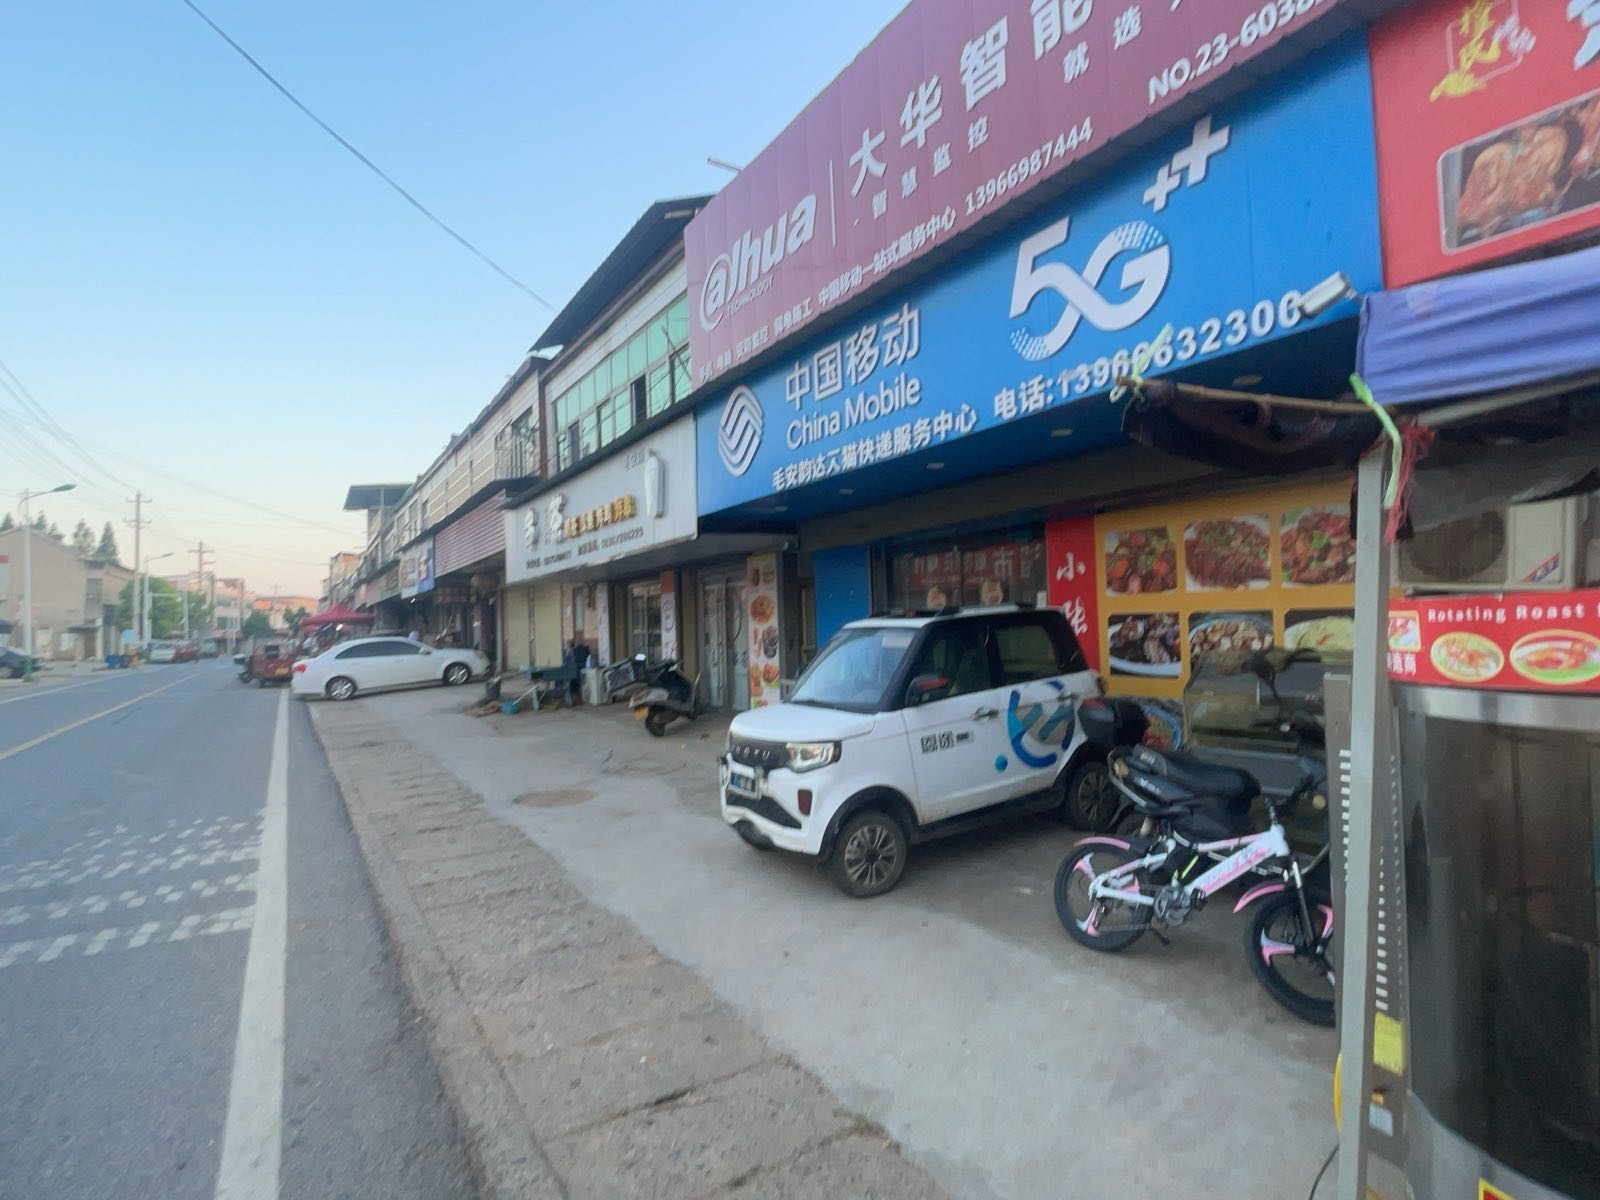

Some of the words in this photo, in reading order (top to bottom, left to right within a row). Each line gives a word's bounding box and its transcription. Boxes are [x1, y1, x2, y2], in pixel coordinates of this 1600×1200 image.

[1062, 0, 1183, 84] 就选
[964, 115, 1094, 216] 13966987444
[784, 302, 921, 411] 中国移动
[787, 410, 841, 450] China
[844, 372, 921, 428] Mobile
[1427, 606, 1507, 624] Rotating
[1516, 603, 1585, 620] Roast
